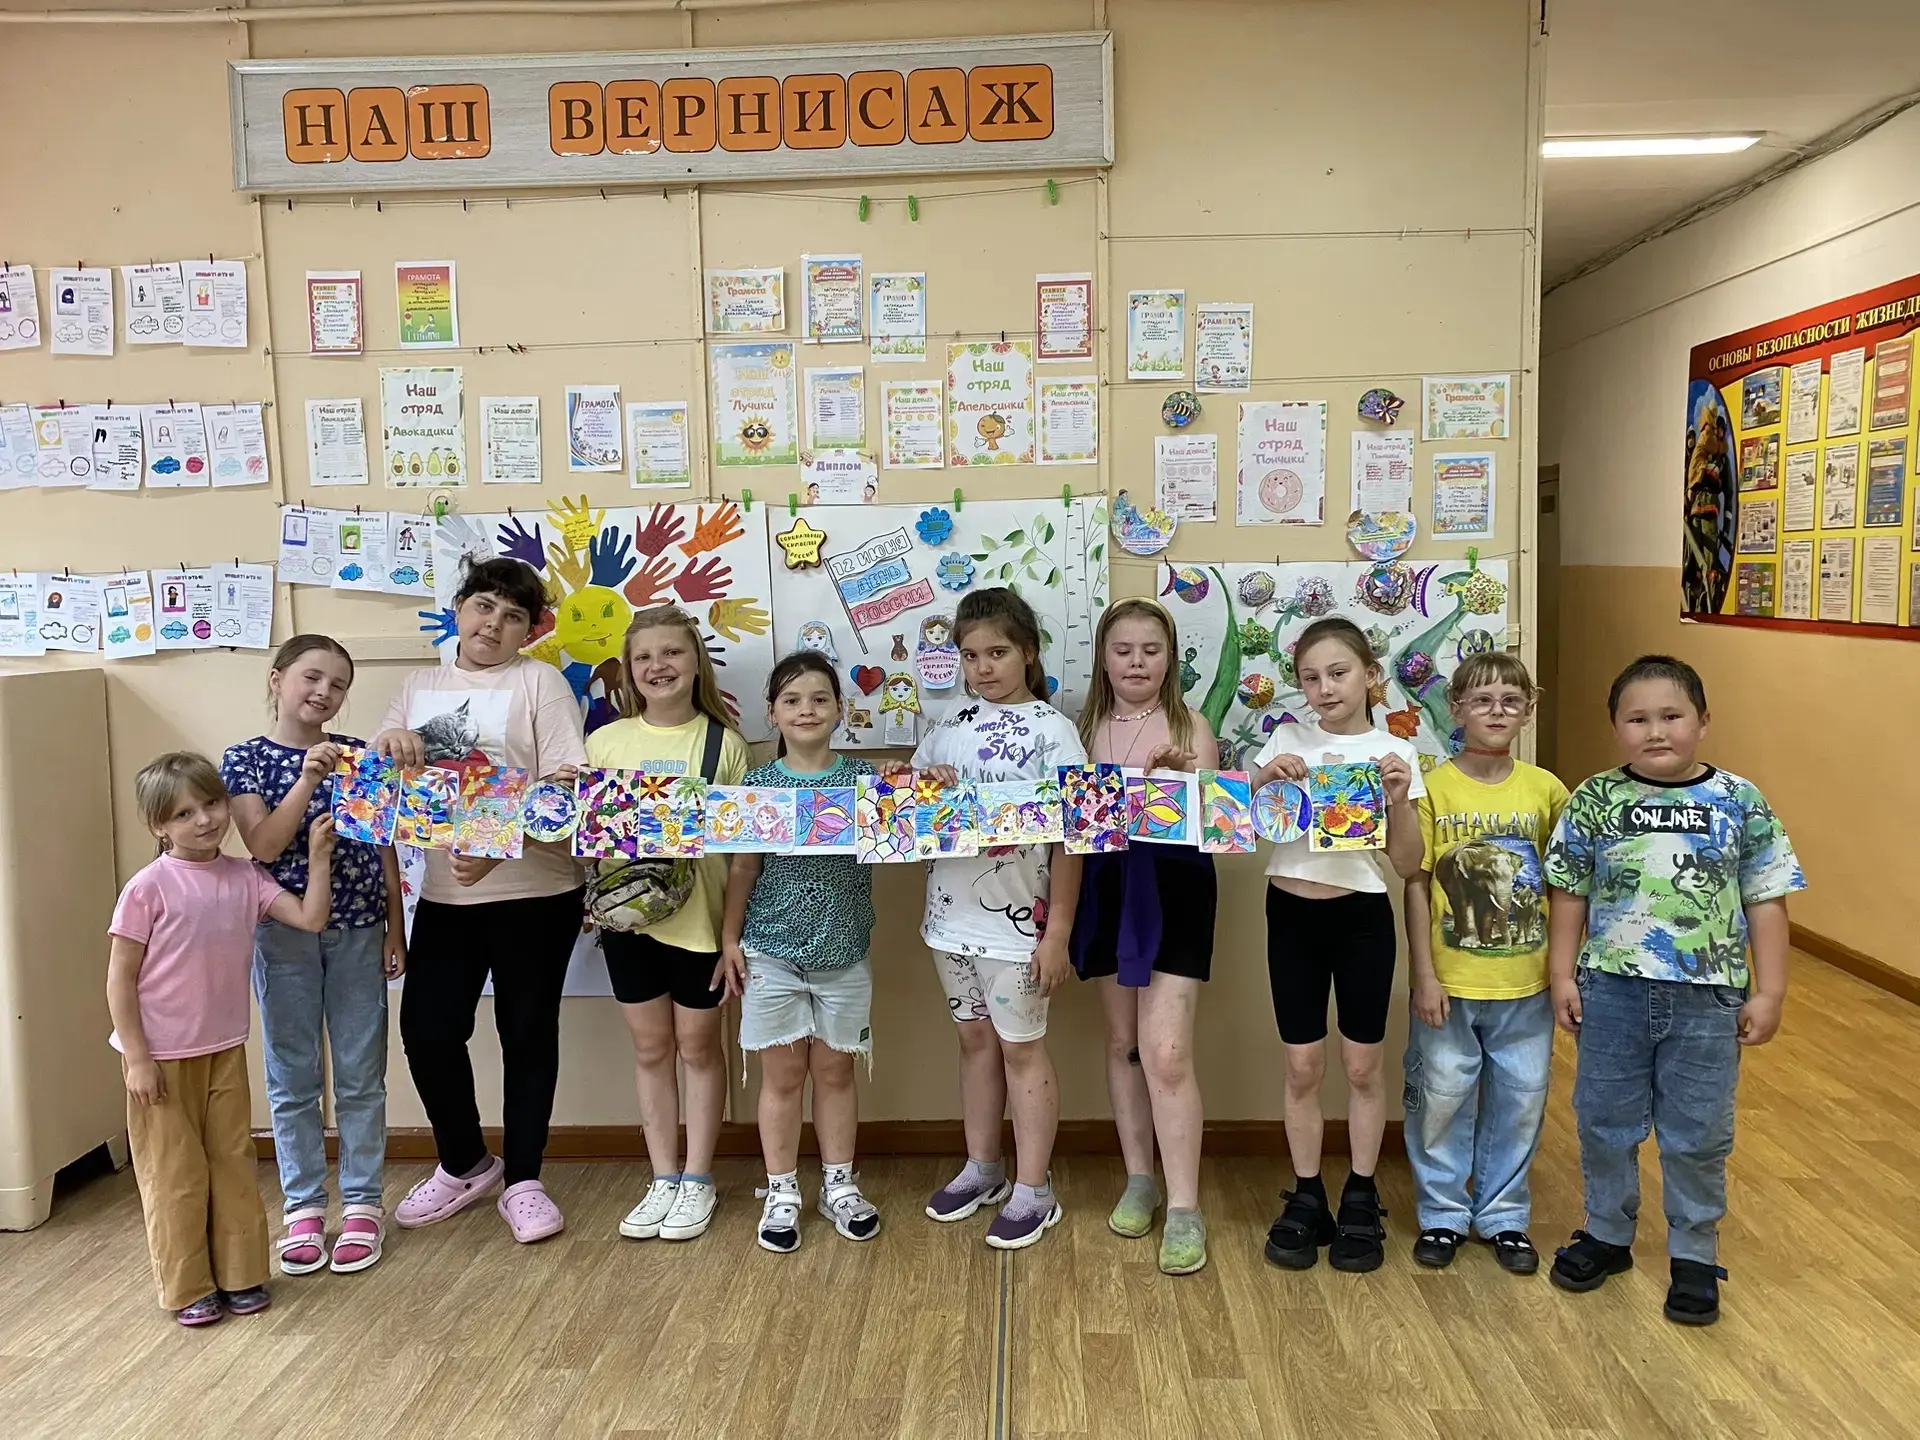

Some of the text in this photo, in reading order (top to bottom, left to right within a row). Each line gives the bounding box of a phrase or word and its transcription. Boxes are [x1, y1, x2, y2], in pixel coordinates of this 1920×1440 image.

[293, 81, 1043, 147] НАШ ВЕРНИСАЖ
[727, 287, 767, 297] Грамота
[1140, 311, 1174, 319] ГРАМОТА
[1708, 346, 1752, 372] ОСНОВЫ
[1756, 316, 1851, 358] БЕЗОПАСНОСТИ
[972, 358, 1005, 373] Наш
[405, 383, 437, 397] Наш
[966, 379, 1012, 394] отряд
[1067, 390, 1090, 398] отряд
[1444, 393, 1486, 403] Грамота
[336, 407, 356, 415] отряд
[400, 403, 444, 417] отряд
[493, 407, 510, 415] Наш
[580, 400, 615, 408] ГРАМОТА
[1264, 418, 1297, 432] Наш
[1258, 438, 1303, 451] отряд
[815, 461, 862, 472] Диплом
[790, 550, 814, 559] РОССИИ
[832, 534, 908, 577] 12 ИЮНЯ
[857, 565, 901, 596] ДЕНЬ
[856, 586, 925, 625] РОССИИ
[923, 669, 954, 680] РОССИИ
[999, 710, 1026, 726] FLY
[974, 721, 1030, 737] HIGH TO
[991, 731, 1010, 739] THE
[988, 738, 1036, 769] SKY
[640, 759, 688, 775] GOOD
[1630, 806, 1708, 830] ONLINE
[1435, 811, 1539, 844] THAILAN
[1679, 900, 1695, 910] NO
